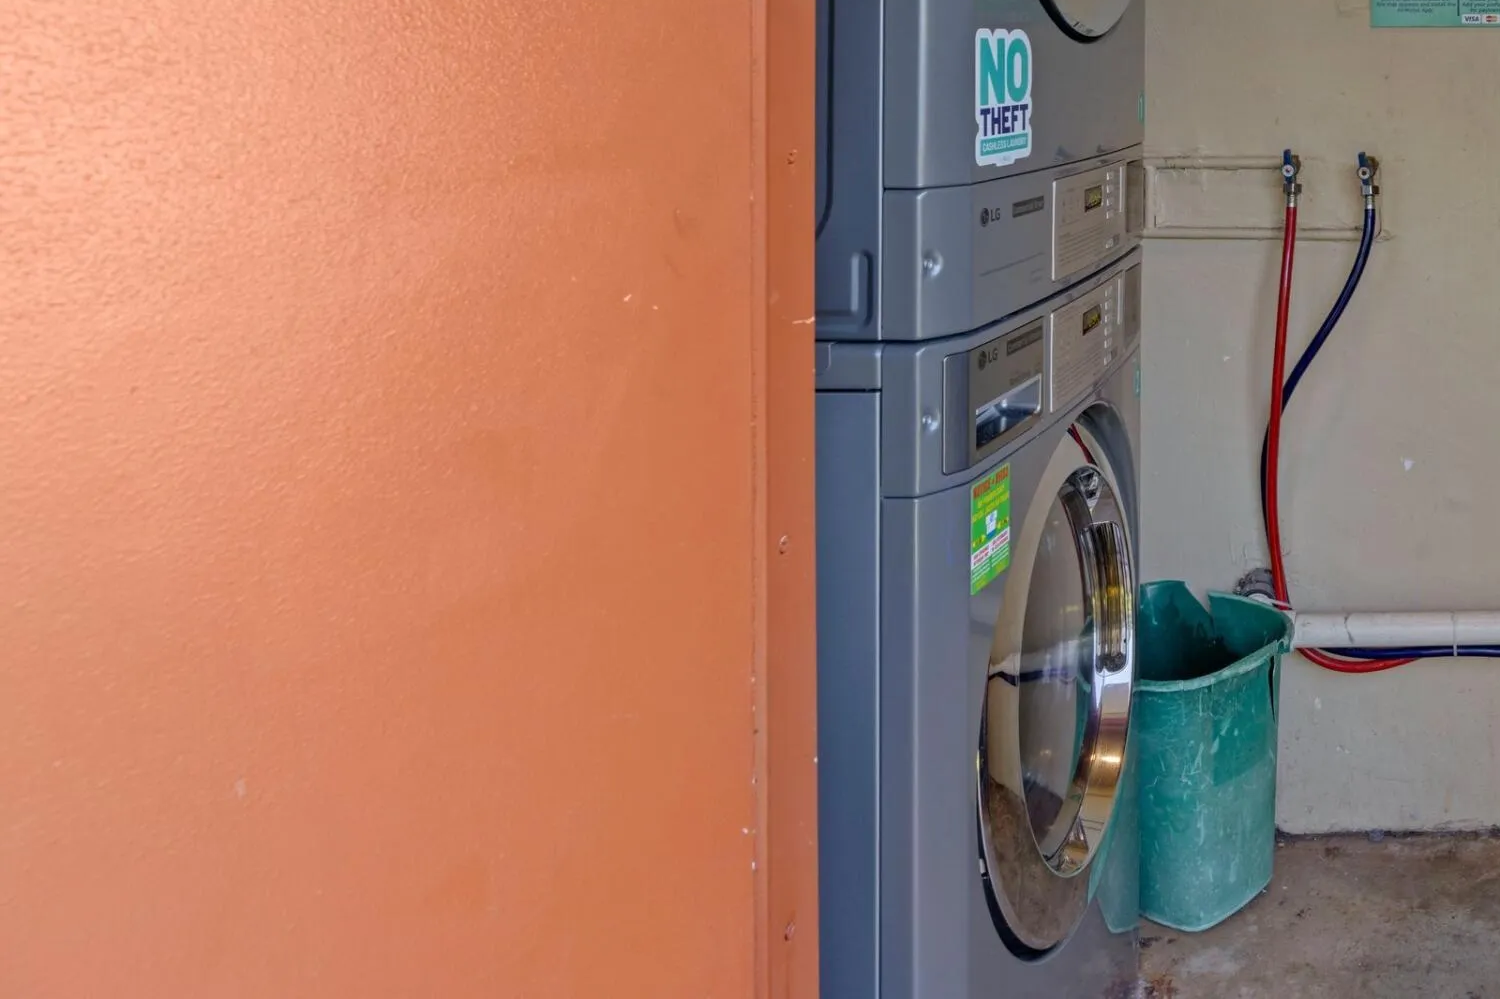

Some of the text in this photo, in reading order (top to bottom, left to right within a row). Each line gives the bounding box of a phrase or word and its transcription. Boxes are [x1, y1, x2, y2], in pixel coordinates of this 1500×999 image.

[980, 36, 1029, 106] NO
[979, 103, 1029, 137] THEFT
[982, 138, 1007, 152] CASHLESS
[990, 207, 1001, 222] LG
[987, 347, 998, 364] LG
